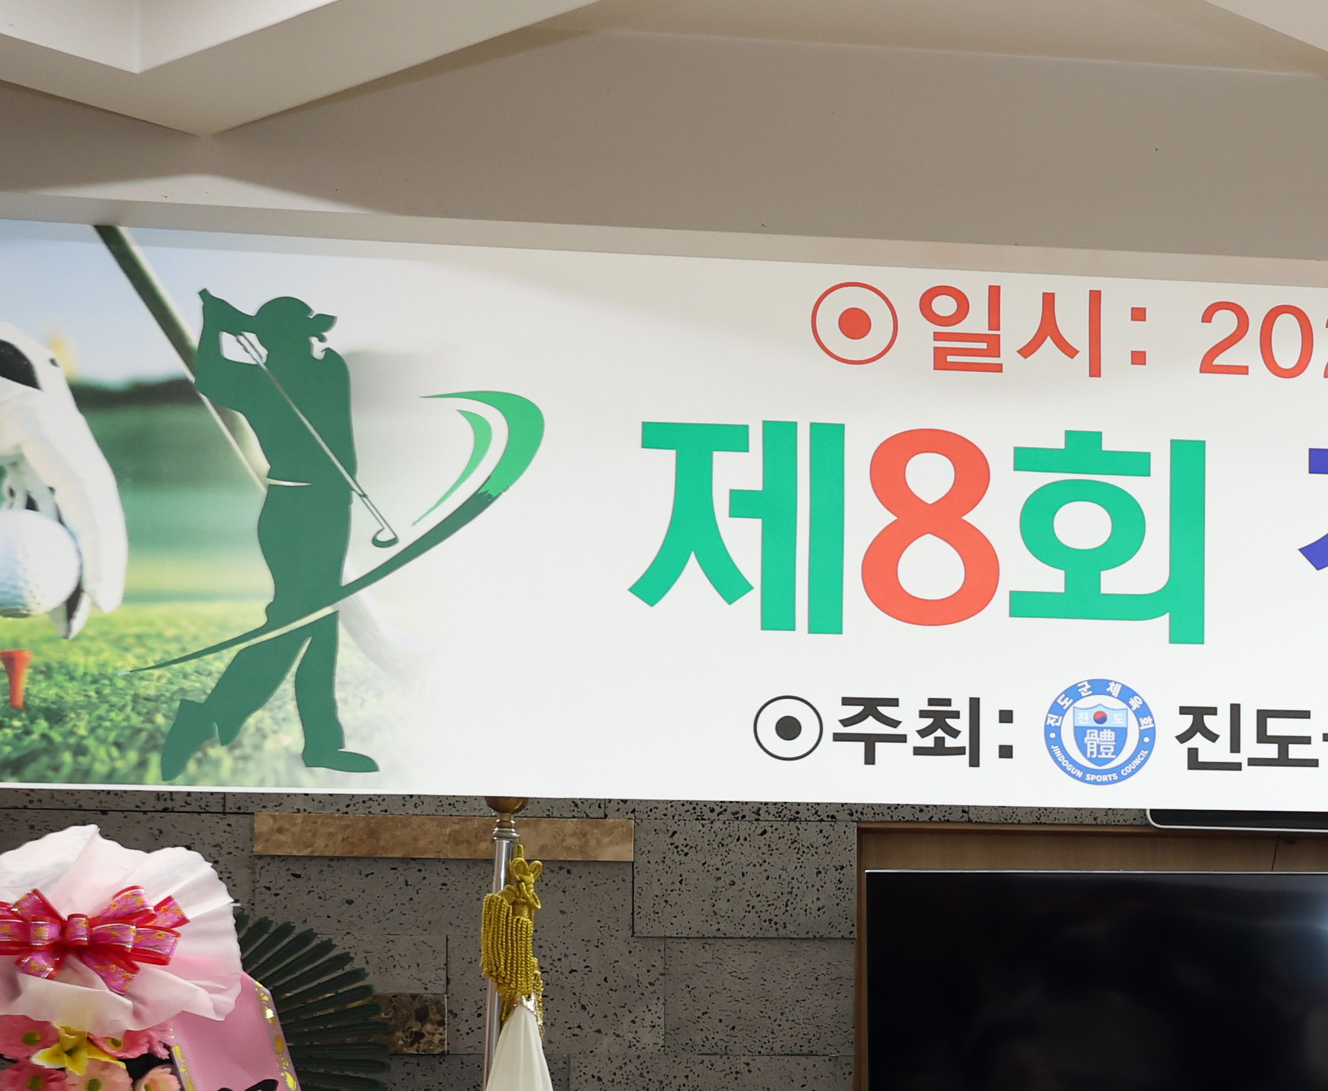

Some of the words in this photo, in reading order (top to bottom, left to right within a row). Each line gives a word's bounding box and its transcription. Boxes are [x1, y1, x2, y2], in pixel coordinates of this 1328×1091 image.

[919, 285, 1147, 378] 일시:
[627, 419, 1207, 645] 제8회
[832, 696, 1014, 768] 주최:
[1051, 744, 1084, 778] JINDOGUN
[1085, 772, 1119, 783] SPORTS
[1120, 748, 1149, 777] COUNCIL
[1084, 728, 1117, 759] 體
